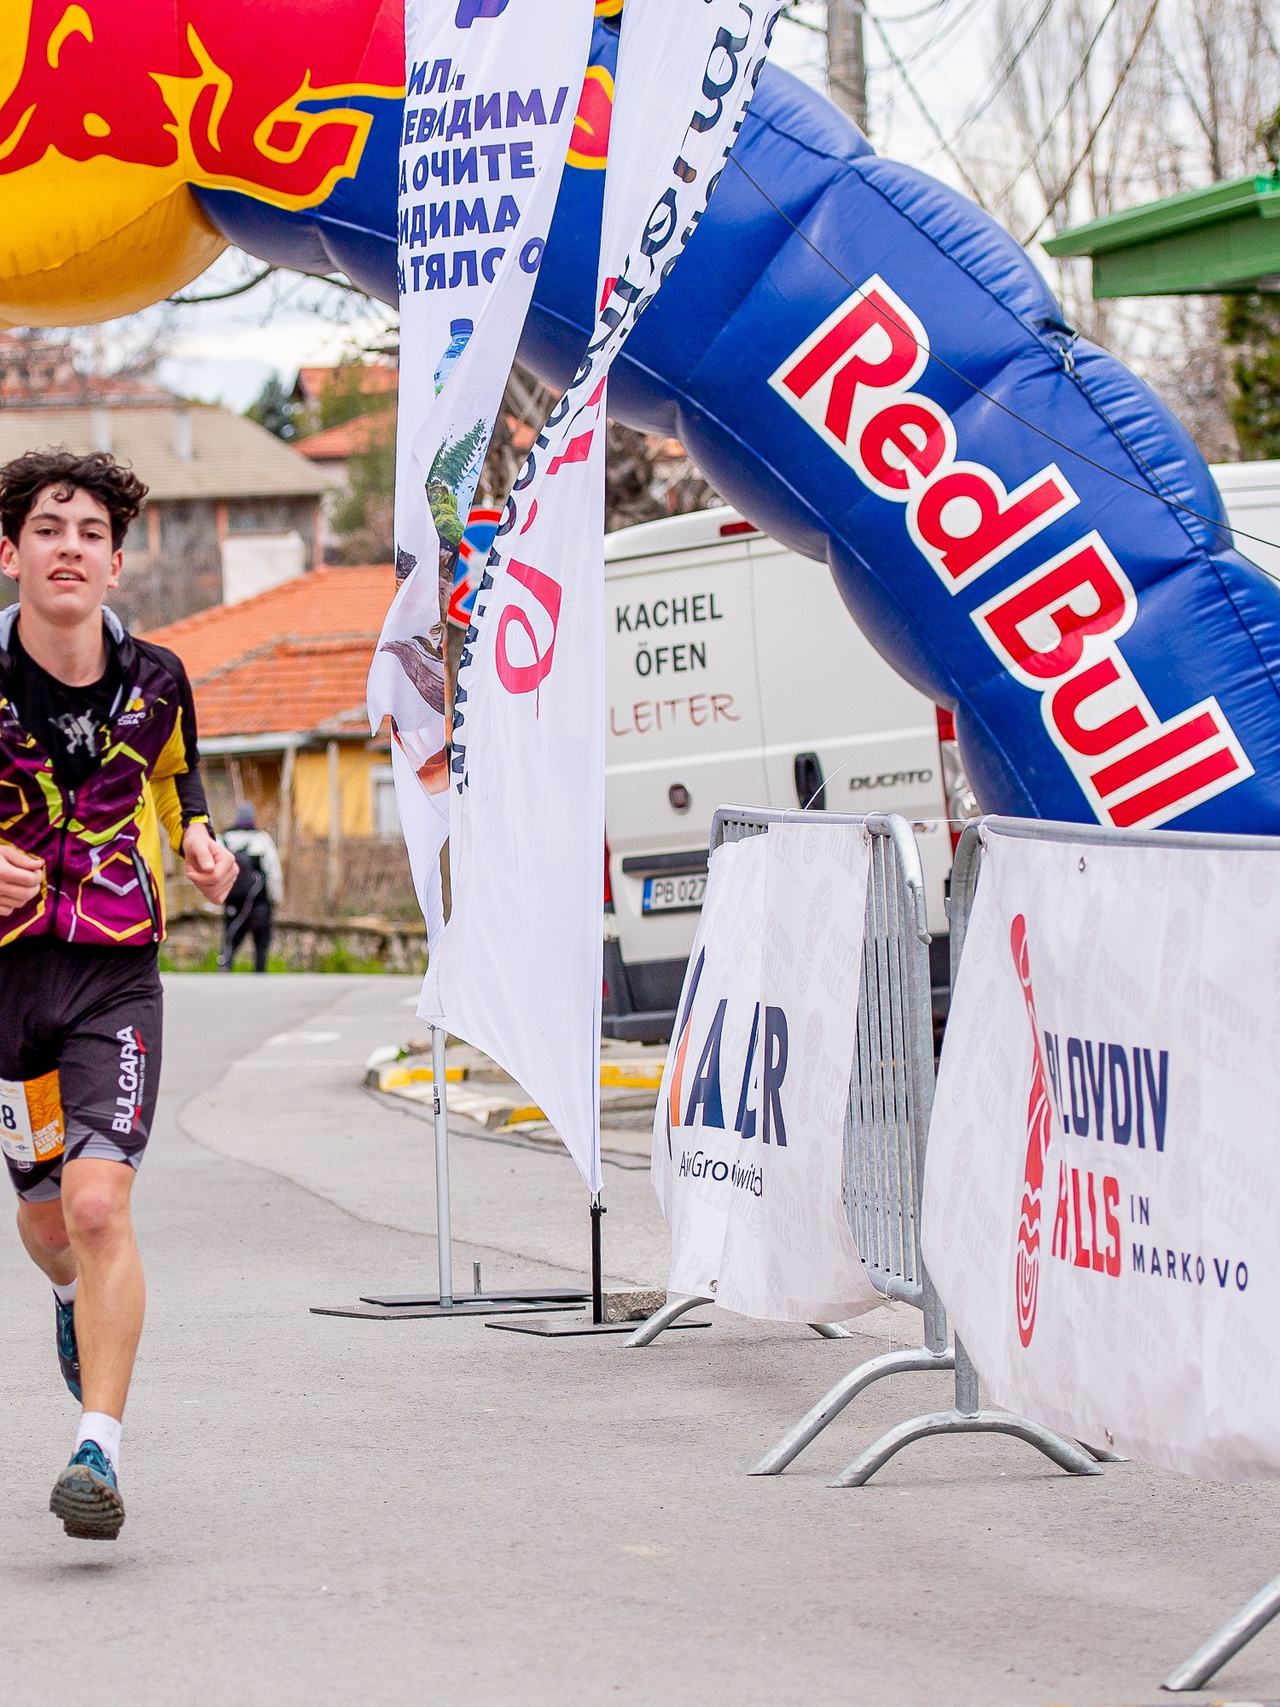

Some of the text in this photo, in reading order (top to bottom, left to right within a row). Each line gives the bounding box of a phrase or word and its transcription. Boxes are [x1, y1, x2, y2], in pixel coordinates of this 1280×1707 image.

[398, 194, 521, 250] ИДИМА
[778, 282, 1243, 829] Red Bull
[616, 593, 723, 633] KACHEL
[635, 641, 707, 677] ÖFEN
[609, 692, 742, 737] LEITER
[849, 769, 933, 792] DUCATO
[1043, 1030, 1169, 1152] PLOVDIV
[1130, 1194, 1150, 1226] IN
[1132, 1242, 1249, 1292] MARKOVO
